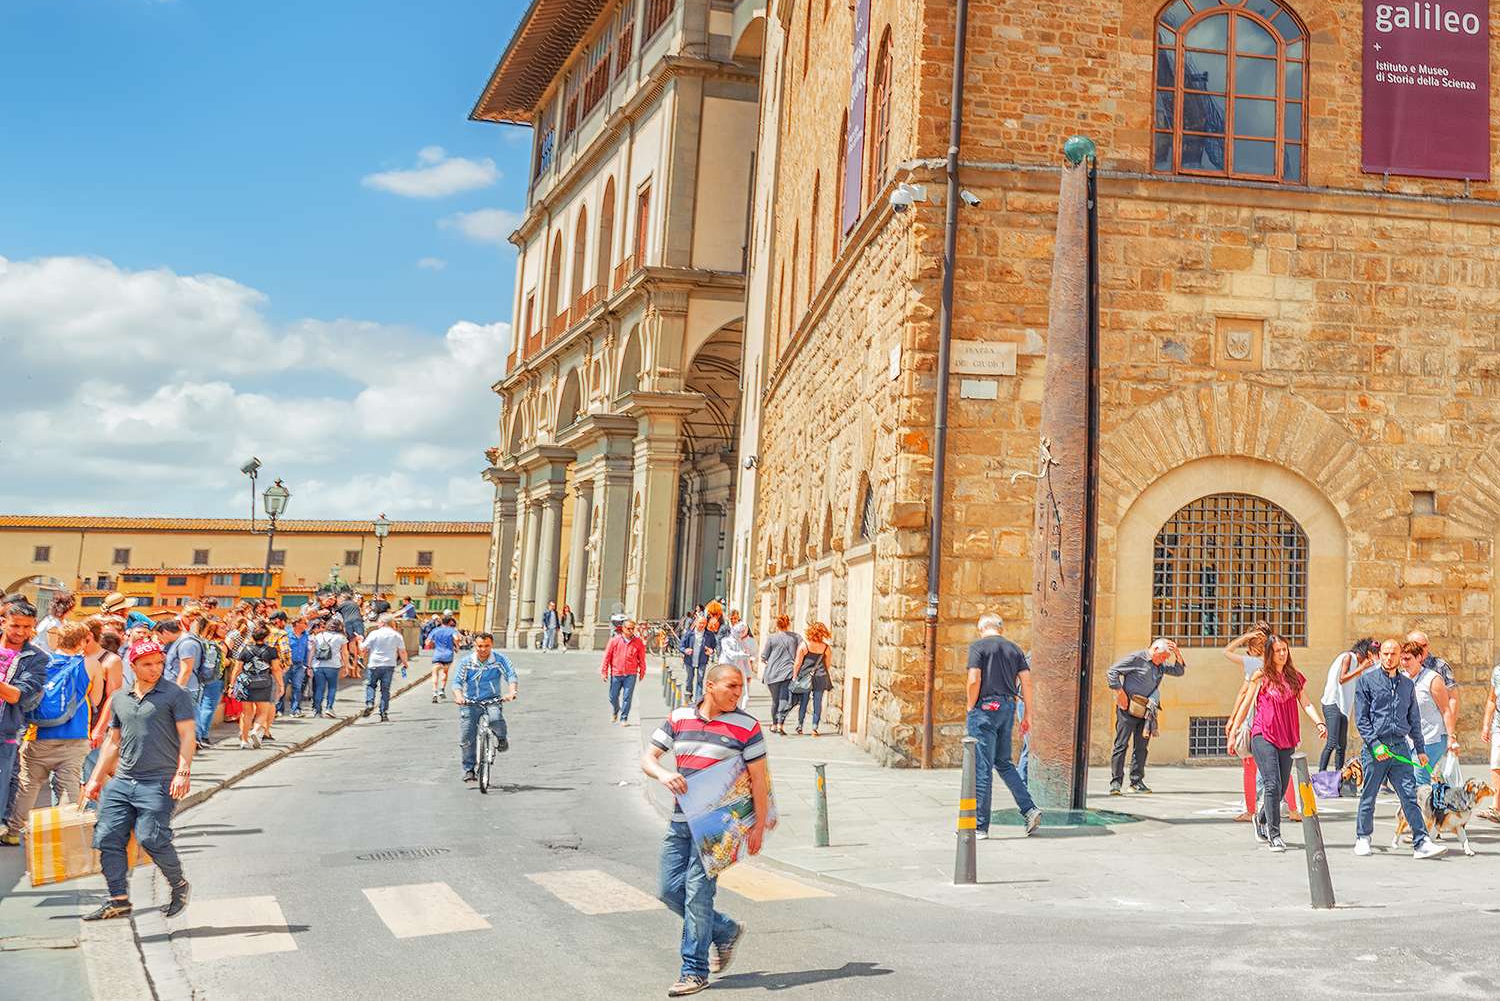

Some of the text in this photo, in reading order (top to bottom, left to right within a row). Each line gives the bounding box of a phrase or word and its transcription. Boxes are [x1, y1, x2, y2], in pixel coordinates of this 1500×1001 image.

[1375, 1, 1481, 36] galileo
[1375, 60, 1449, 76] Istituto e Museo
[1375, 71, 1477, 90] di Storia della Scienza
